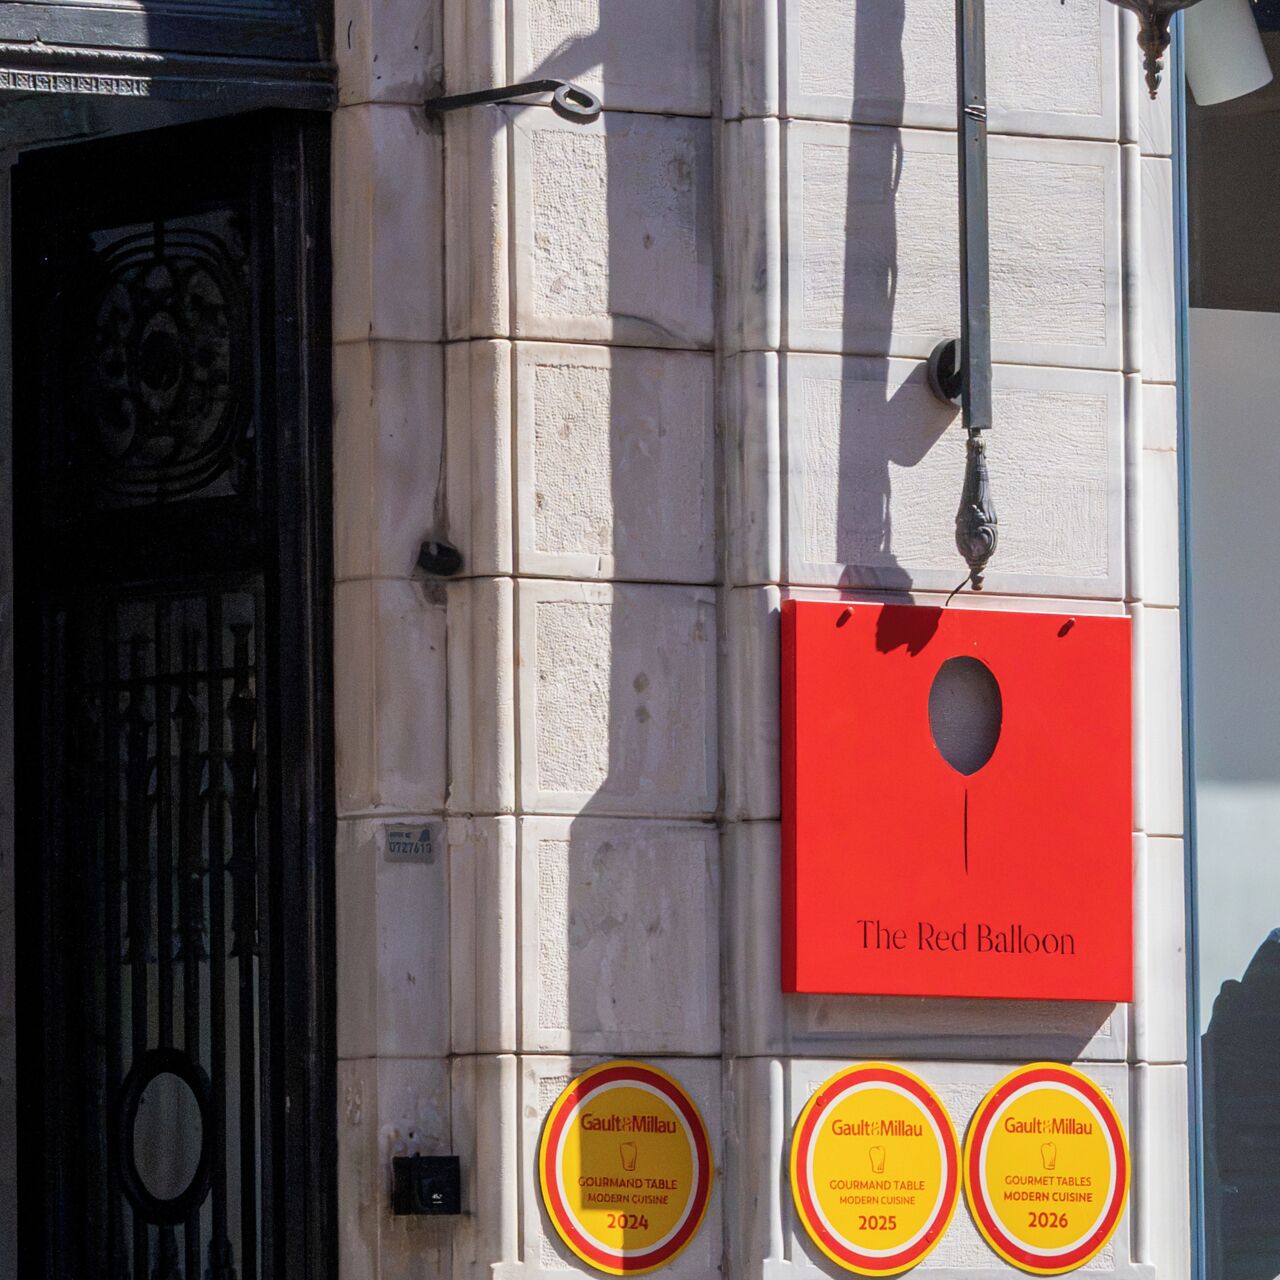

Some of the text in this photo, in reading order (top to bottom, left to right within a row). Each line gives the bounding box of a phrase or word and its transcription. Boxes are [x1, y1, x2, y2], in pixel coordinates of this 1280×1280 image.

[857, 920, 1075, 955] The Red Balloon
[578, 1176, 677, 1190] GOURMAND TABLE
[829, 1179, 925, 1191] GOURMAND TABLE
[1004, 1175, 1092, 1187] GOURMET TABLES
[588, 1192, 669, 1205] MODERN CUISINE
[839, 1195, 916, 1205] MODERN CUISINE
[1003, 1191, 1093, 1202] MODERN CUISINE
[607, 1213, 649, 1230] 2024
[858, 1215, 897, 1231] 2025
[1028, 1211, 1069, 1228] 2026
